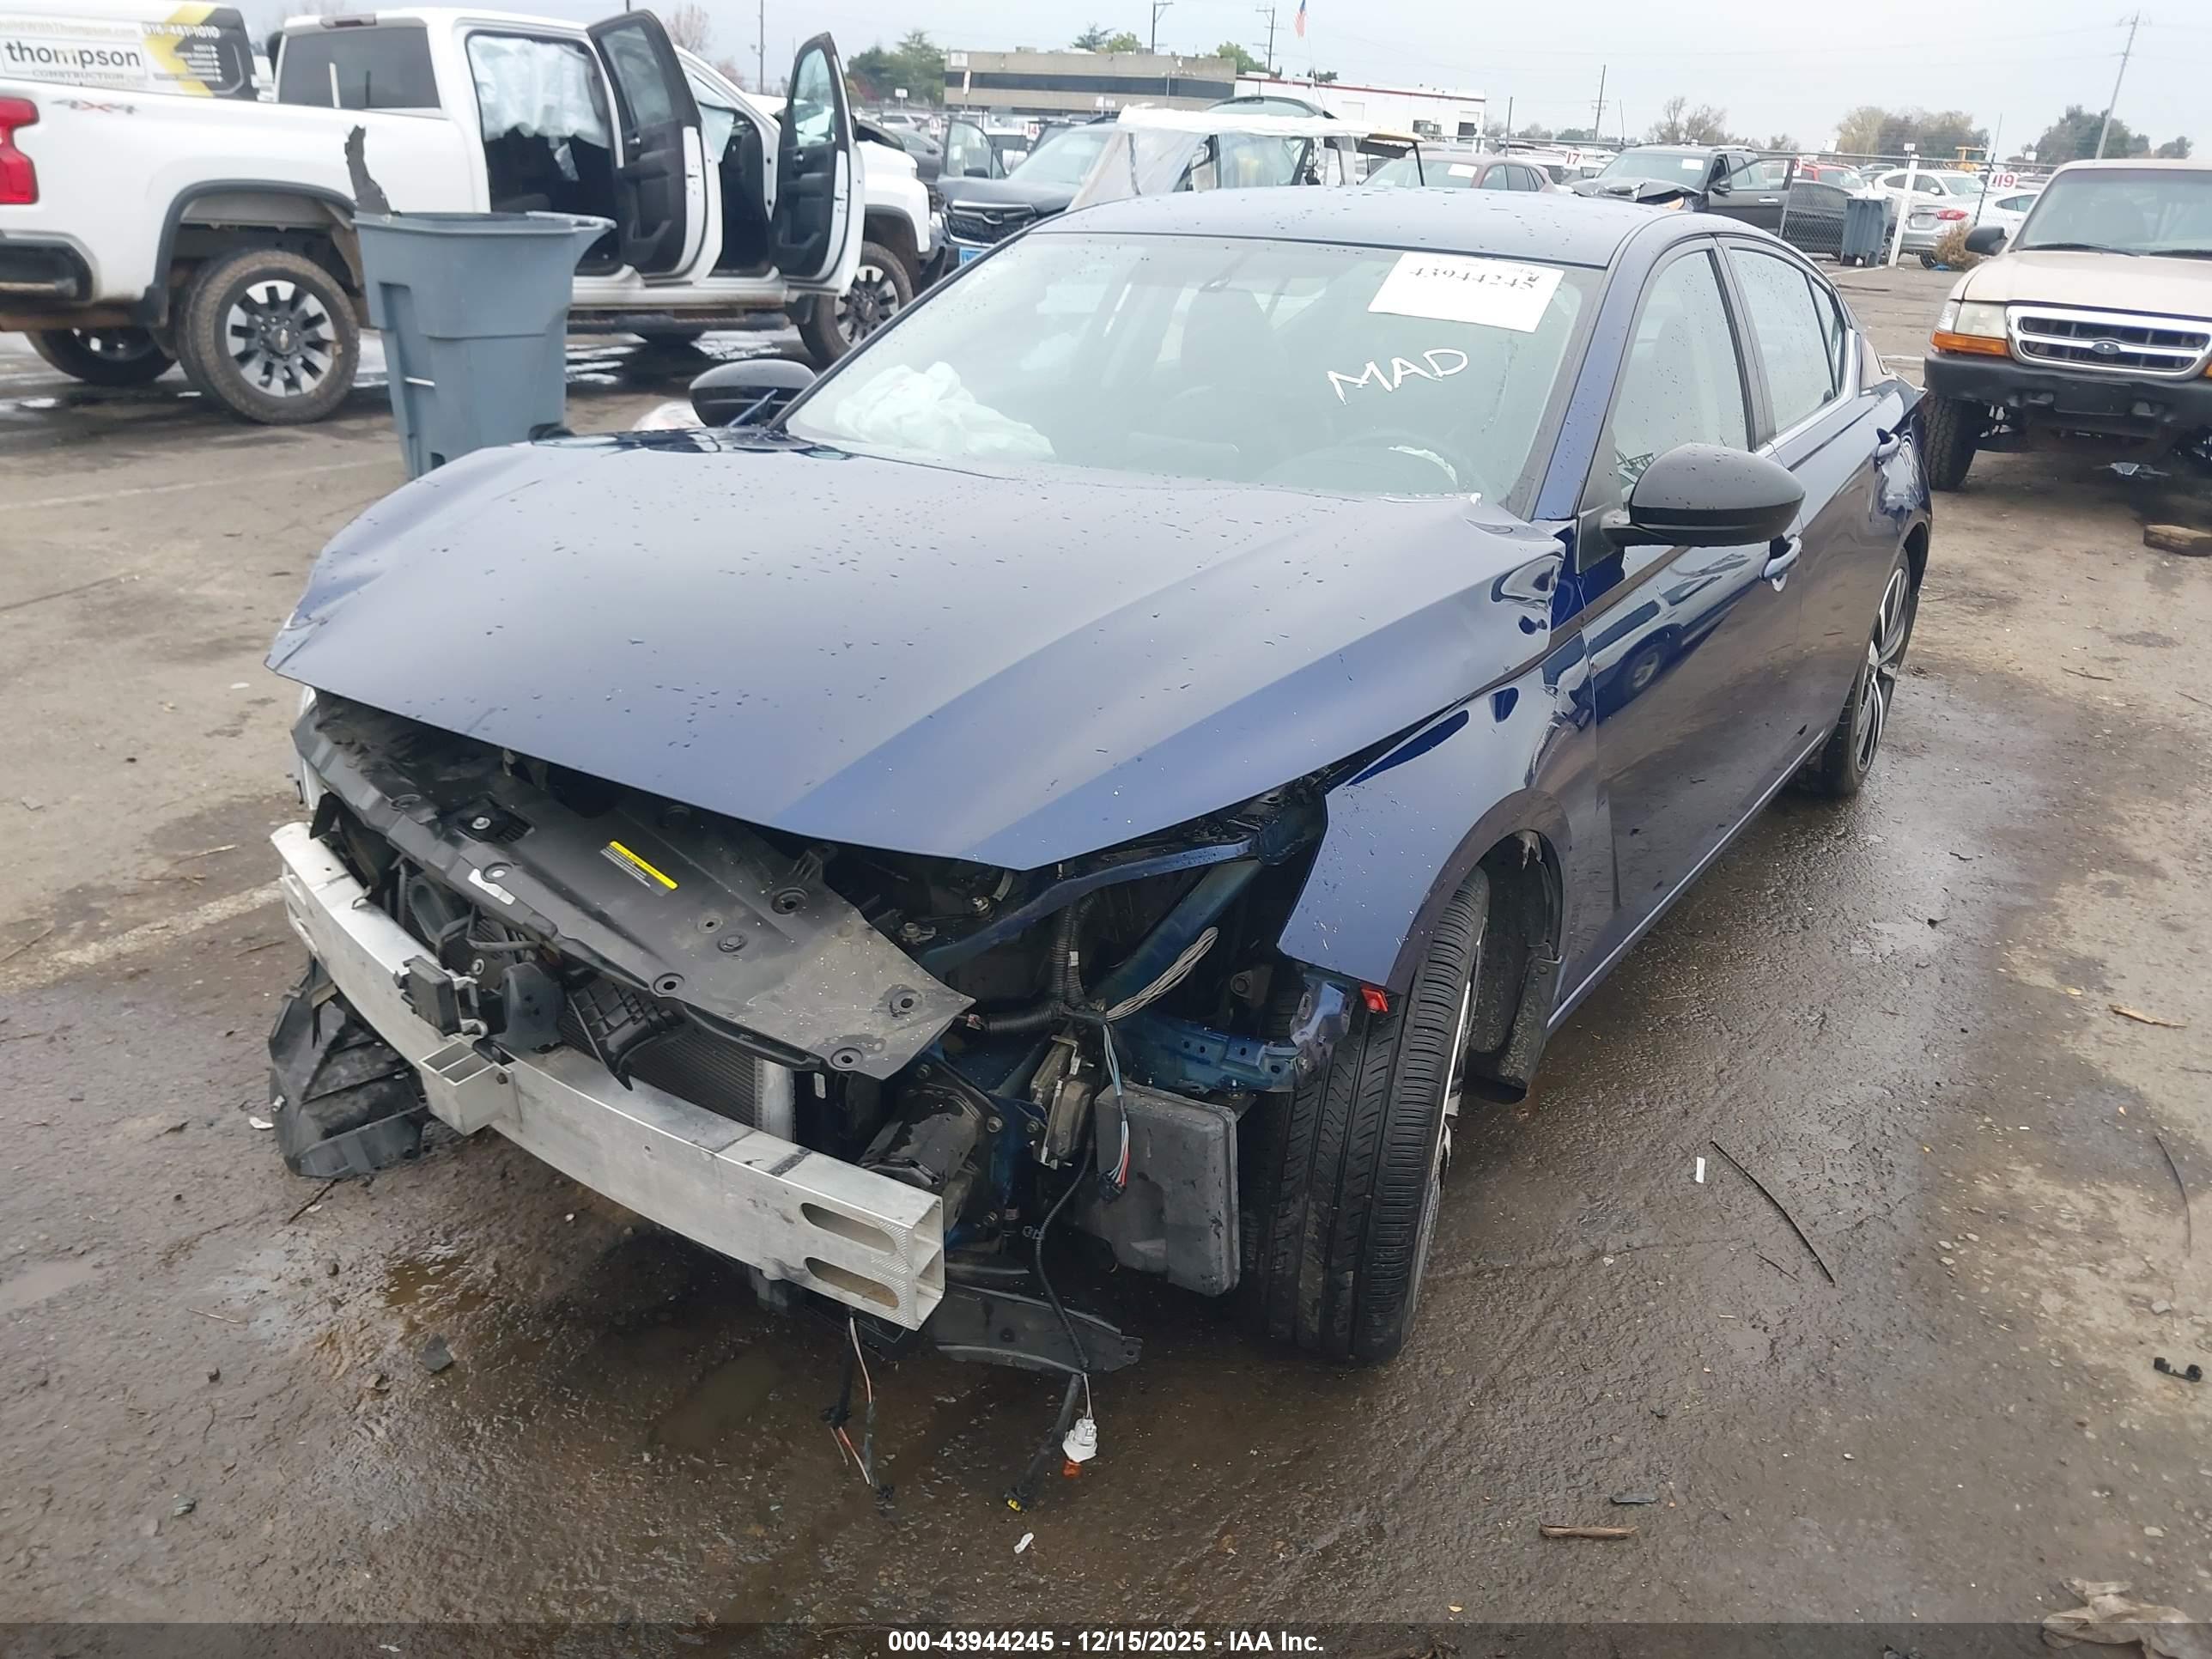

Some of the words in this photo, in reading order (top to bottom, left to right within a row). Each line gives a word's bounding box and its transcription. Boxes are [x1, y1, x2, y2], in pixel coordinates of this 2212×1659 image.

[5, 40, 141, 69] thompson
[32, 69, 125, 80] CONSTRUCTION
[1566, 152, 1581, 165] 17
[1327, 348, 1468, 405] MAD
